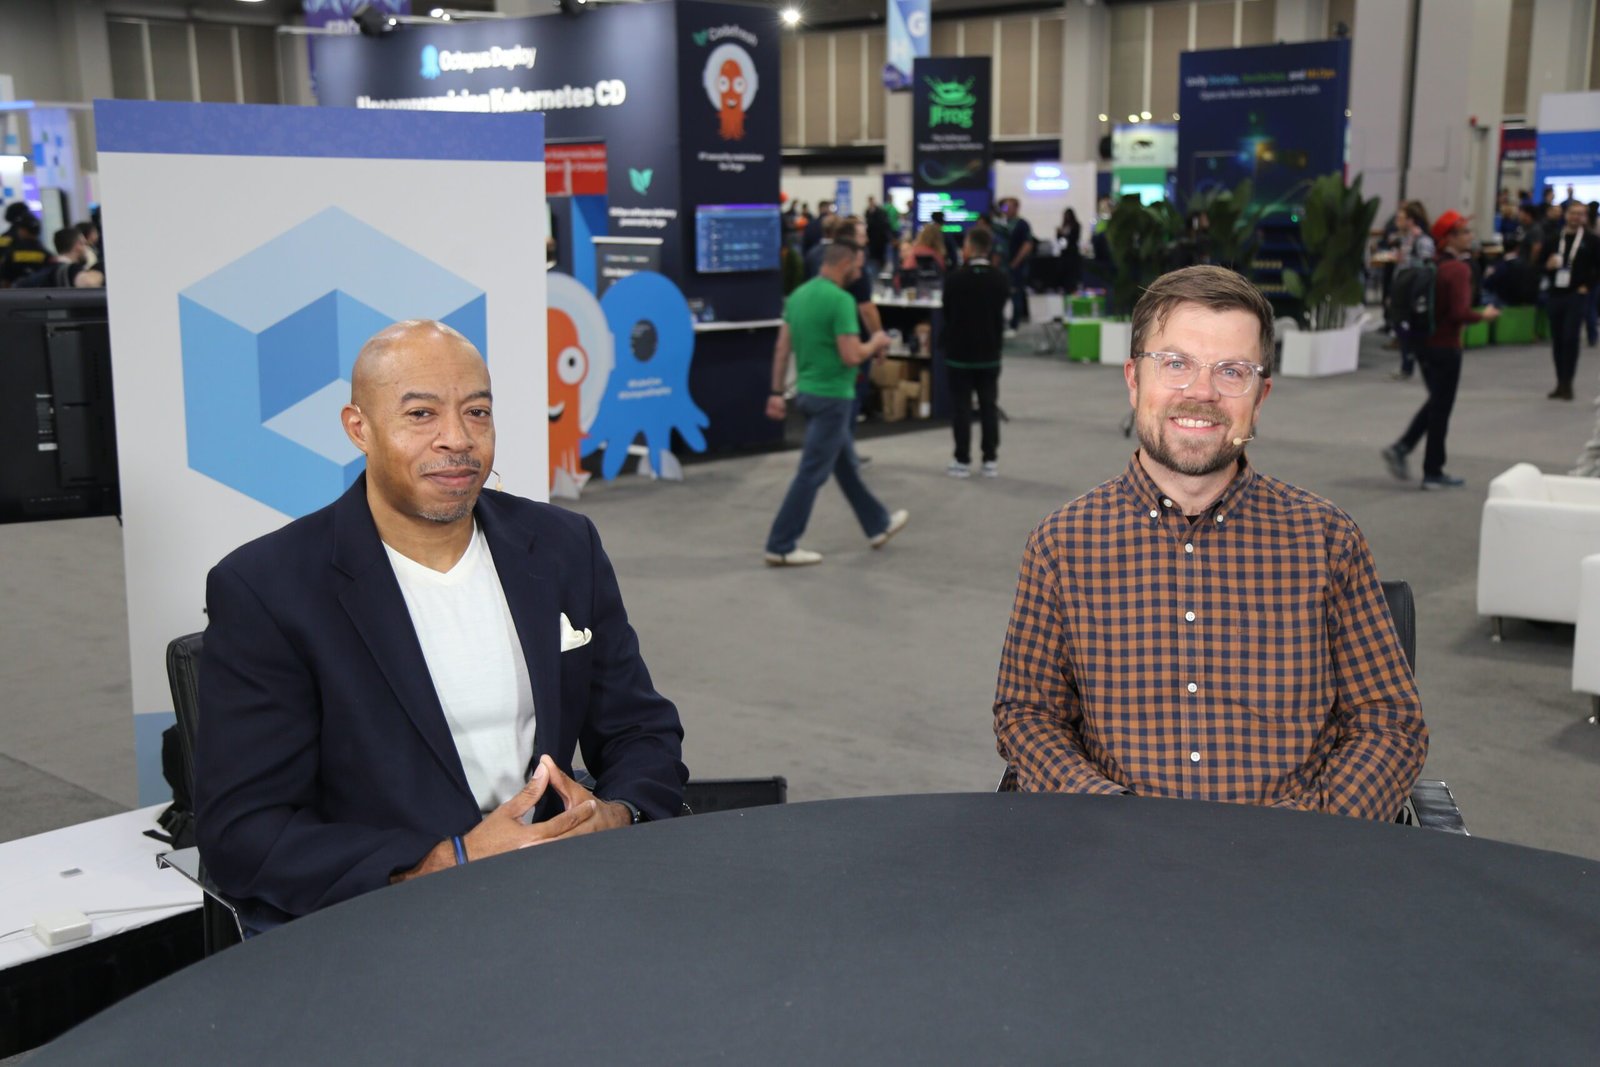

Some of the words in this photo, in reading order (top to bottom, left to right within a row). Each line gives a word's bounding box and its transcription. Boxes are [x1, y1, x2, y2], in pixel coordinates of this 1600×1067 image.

[439, 49, 490, 73] Octopus
[490, 44, 537, 70] Deploy
[490, 85, 595, 112] Kubernetes
[596, 79, 627, 106] CD
